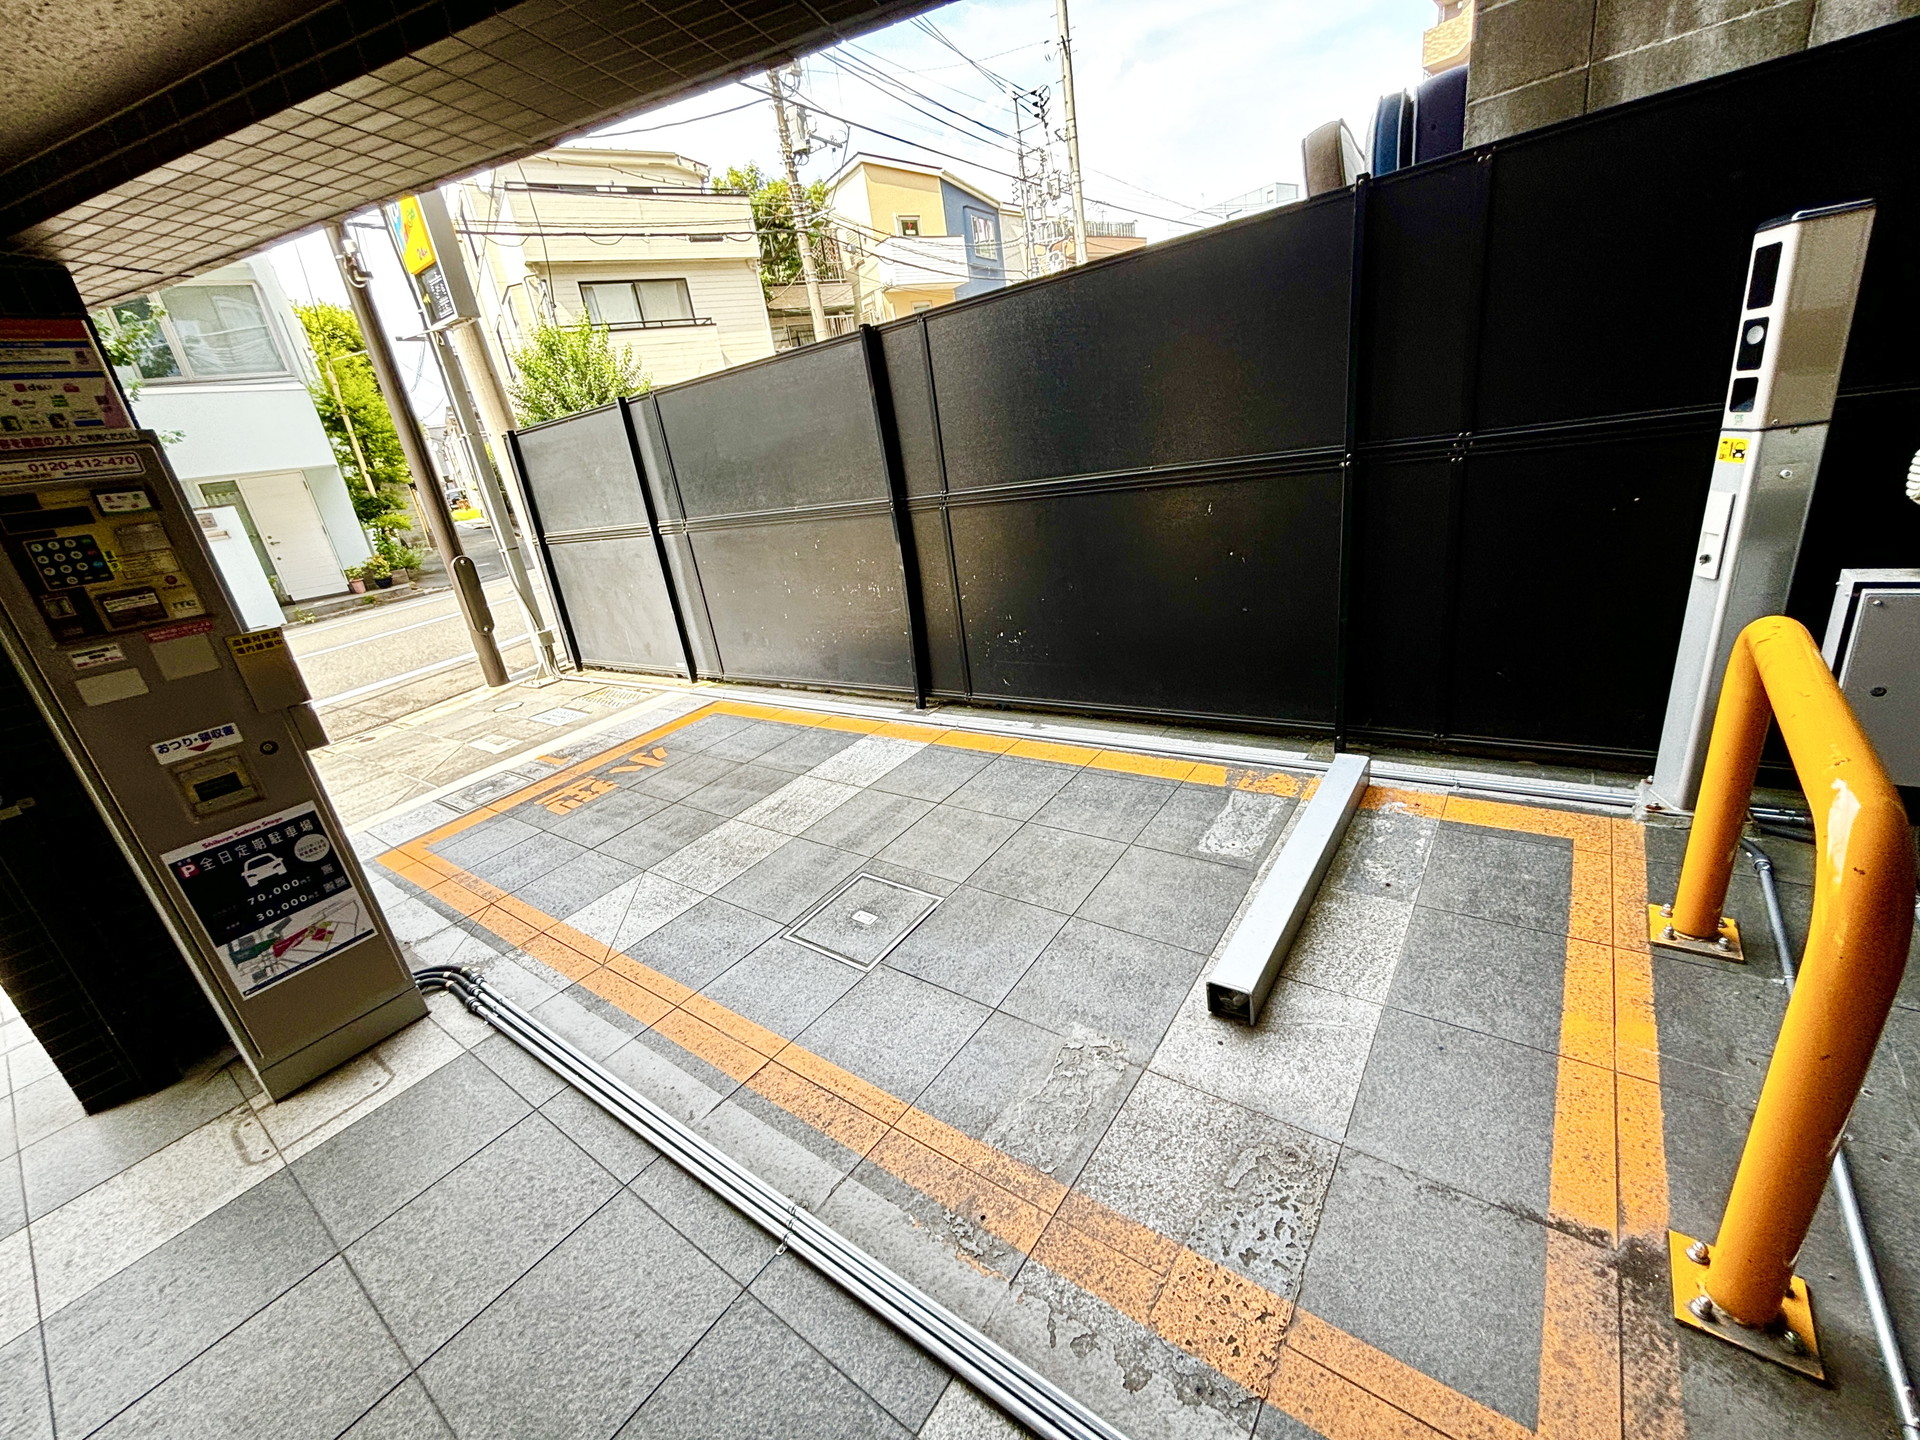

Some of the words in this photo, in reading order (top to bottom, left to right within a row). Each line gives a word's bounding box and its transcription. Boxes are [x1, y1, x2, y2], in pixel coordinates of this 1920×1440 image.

[28, 455, 136, 473] 0120-412-470
[157, 725, 235, 754] おつり・領収書
[534, 747, 669, 816] 小型
[199, 818, 314, 872] 全日定期駐車場
[202, 834, 234, 849] Shibuya
[234, 824, 262, 838] Sakura
[262, 816, 283, 829] Stage
